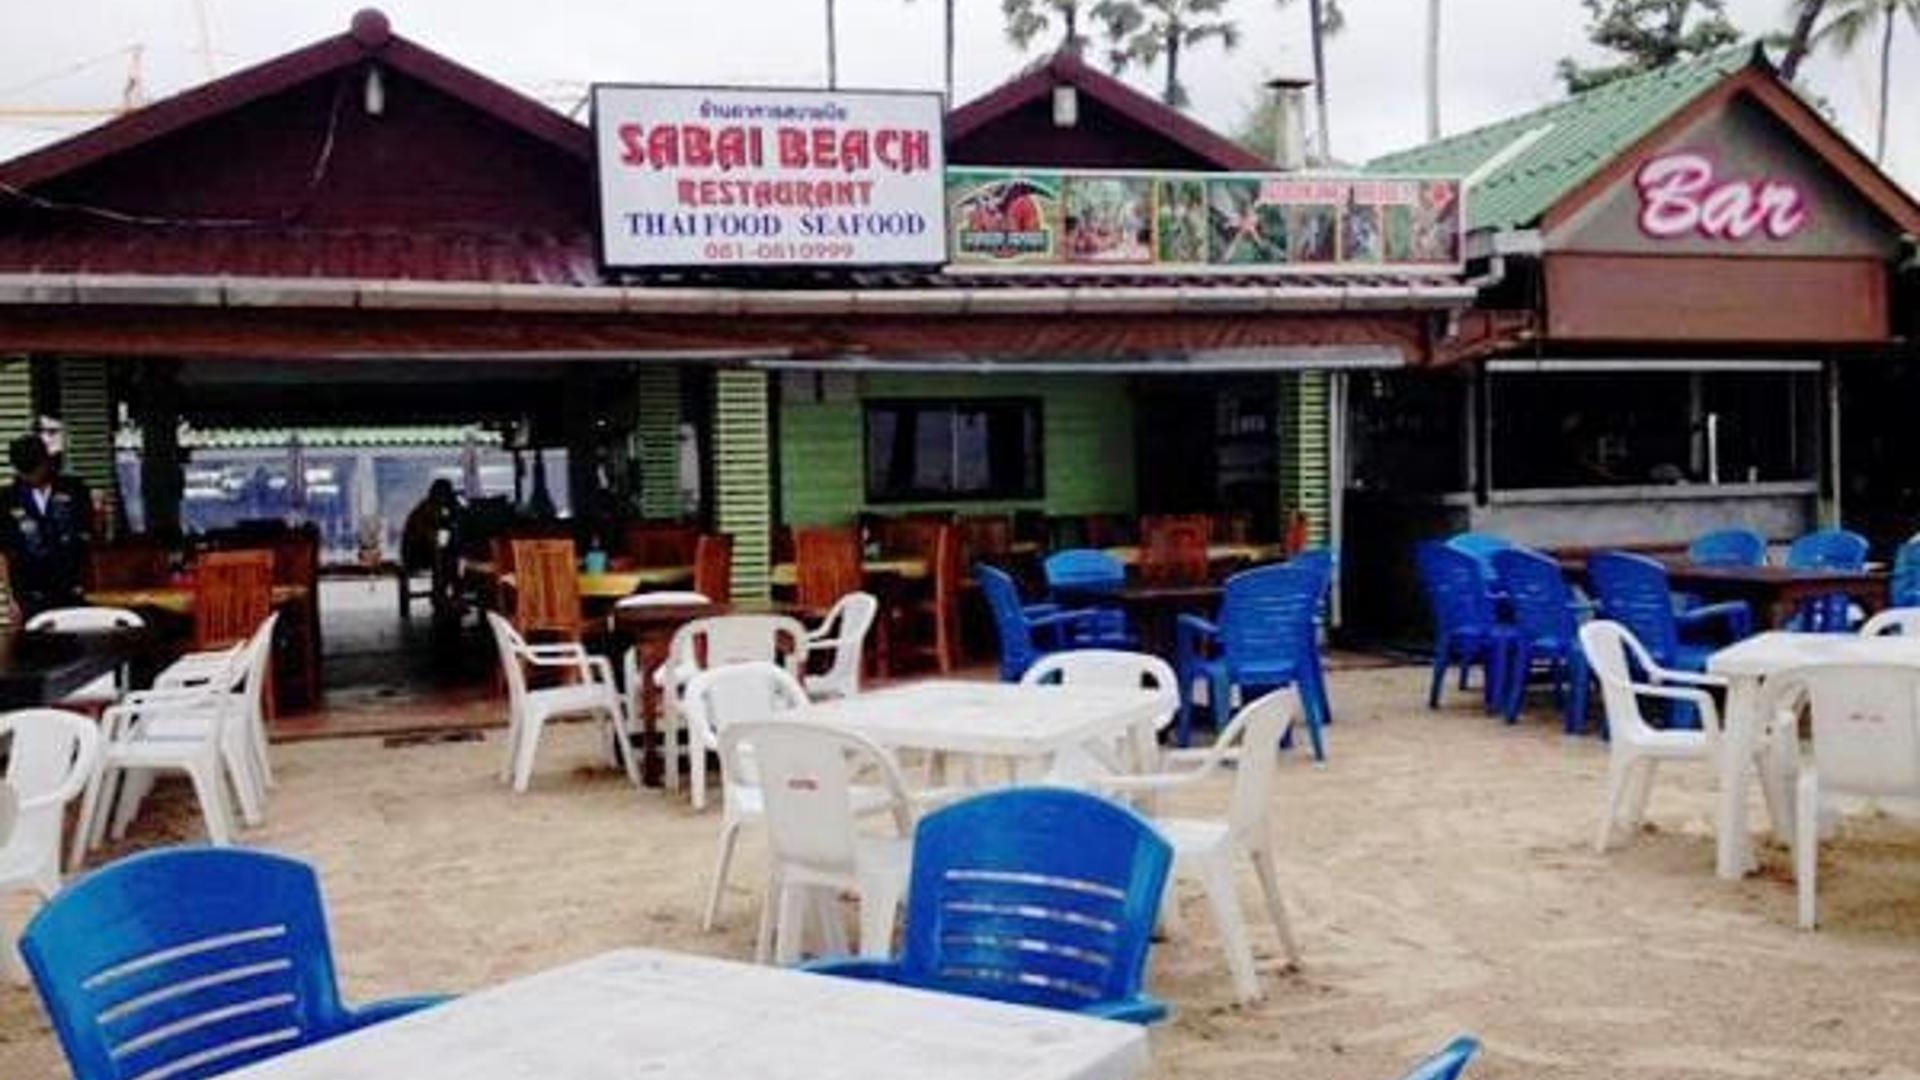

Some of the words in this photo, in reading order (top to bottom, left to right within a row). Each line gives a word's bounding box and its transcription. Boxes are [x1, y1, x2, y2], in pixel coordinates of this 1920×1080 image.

[618, 123, 763, 172] SABAI
[778, 128, 930, 174] BEACH
[677, 179, 874, 208] RESTAURANT
[1636, 153, 1806, 239] Bar
[624, 212, 697, 237] THAI
[702, 212, 782, 237] FOOD
[799, 212, 926, 237] SEAFOOD
